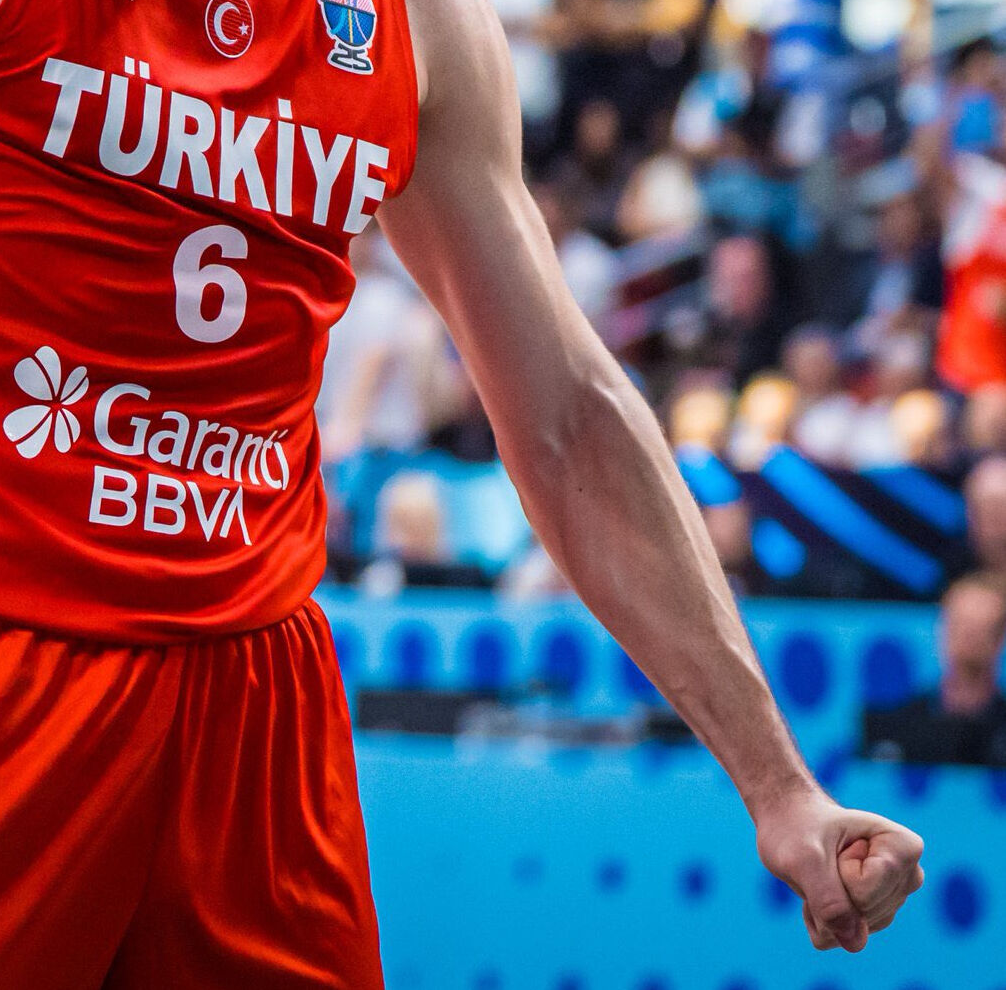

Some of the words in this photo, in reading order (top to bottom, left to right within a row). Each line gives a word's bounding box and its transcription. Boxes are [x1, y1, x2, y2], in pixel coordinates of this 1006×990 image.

[41, 56, 390, 235] TÜRKİYE
[172, 224, 249, 344] 6
[94, 382, 290, 491] Garanti
[88, 464, 253, 546] BBVA
